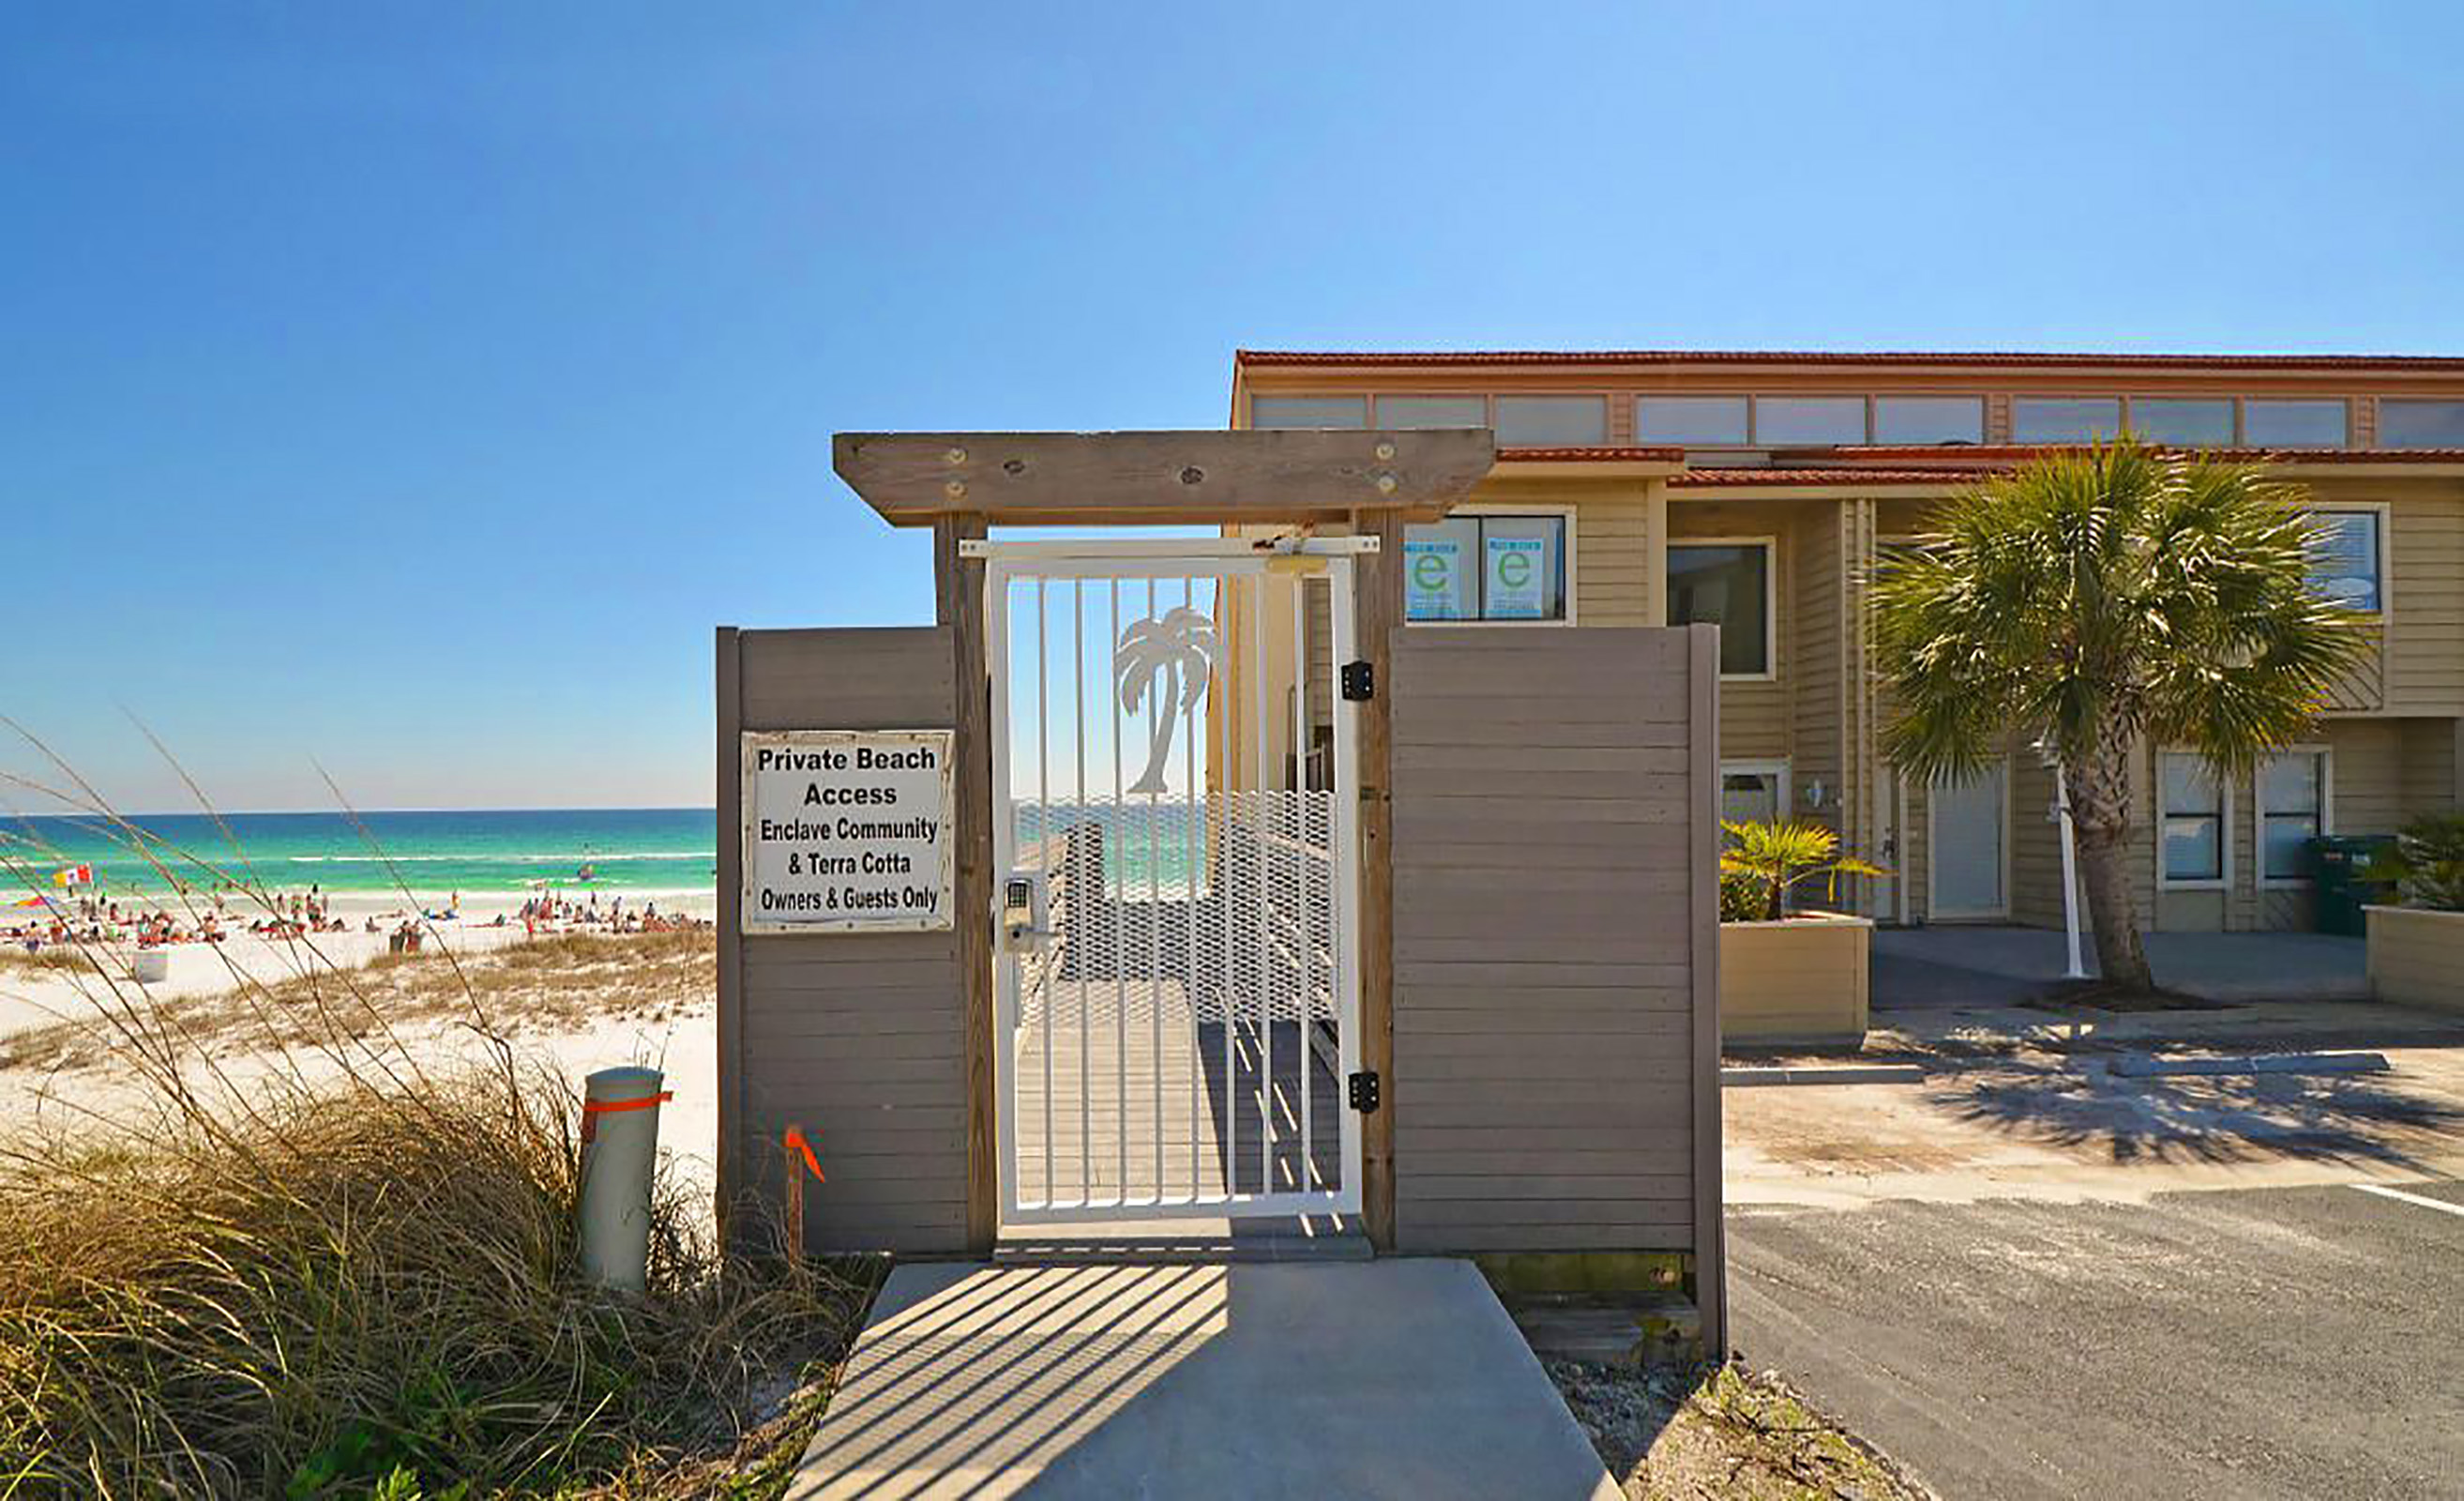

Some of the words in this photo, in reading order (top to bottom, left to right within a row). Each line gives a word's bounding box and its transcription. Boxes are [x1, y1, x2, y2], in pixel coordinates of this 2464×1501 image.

[758, 748, 848, 771] Private
[856, 747, 936, 770] Beach
[804, 782, 898, 806] Access
[761, 819, 831, 841] Enclave
[837, 817, 938, 844] Community
[789, 853, 802, 875] &
[808, 853, 856, 874] Terra
[862, 851, 912, 874] Cotta
[761, 887, 822, 910] Owners
[826, 887, 839, 909] &
[844, 887, 899, 909] Guests
[902, 886, 938, 914] Only
